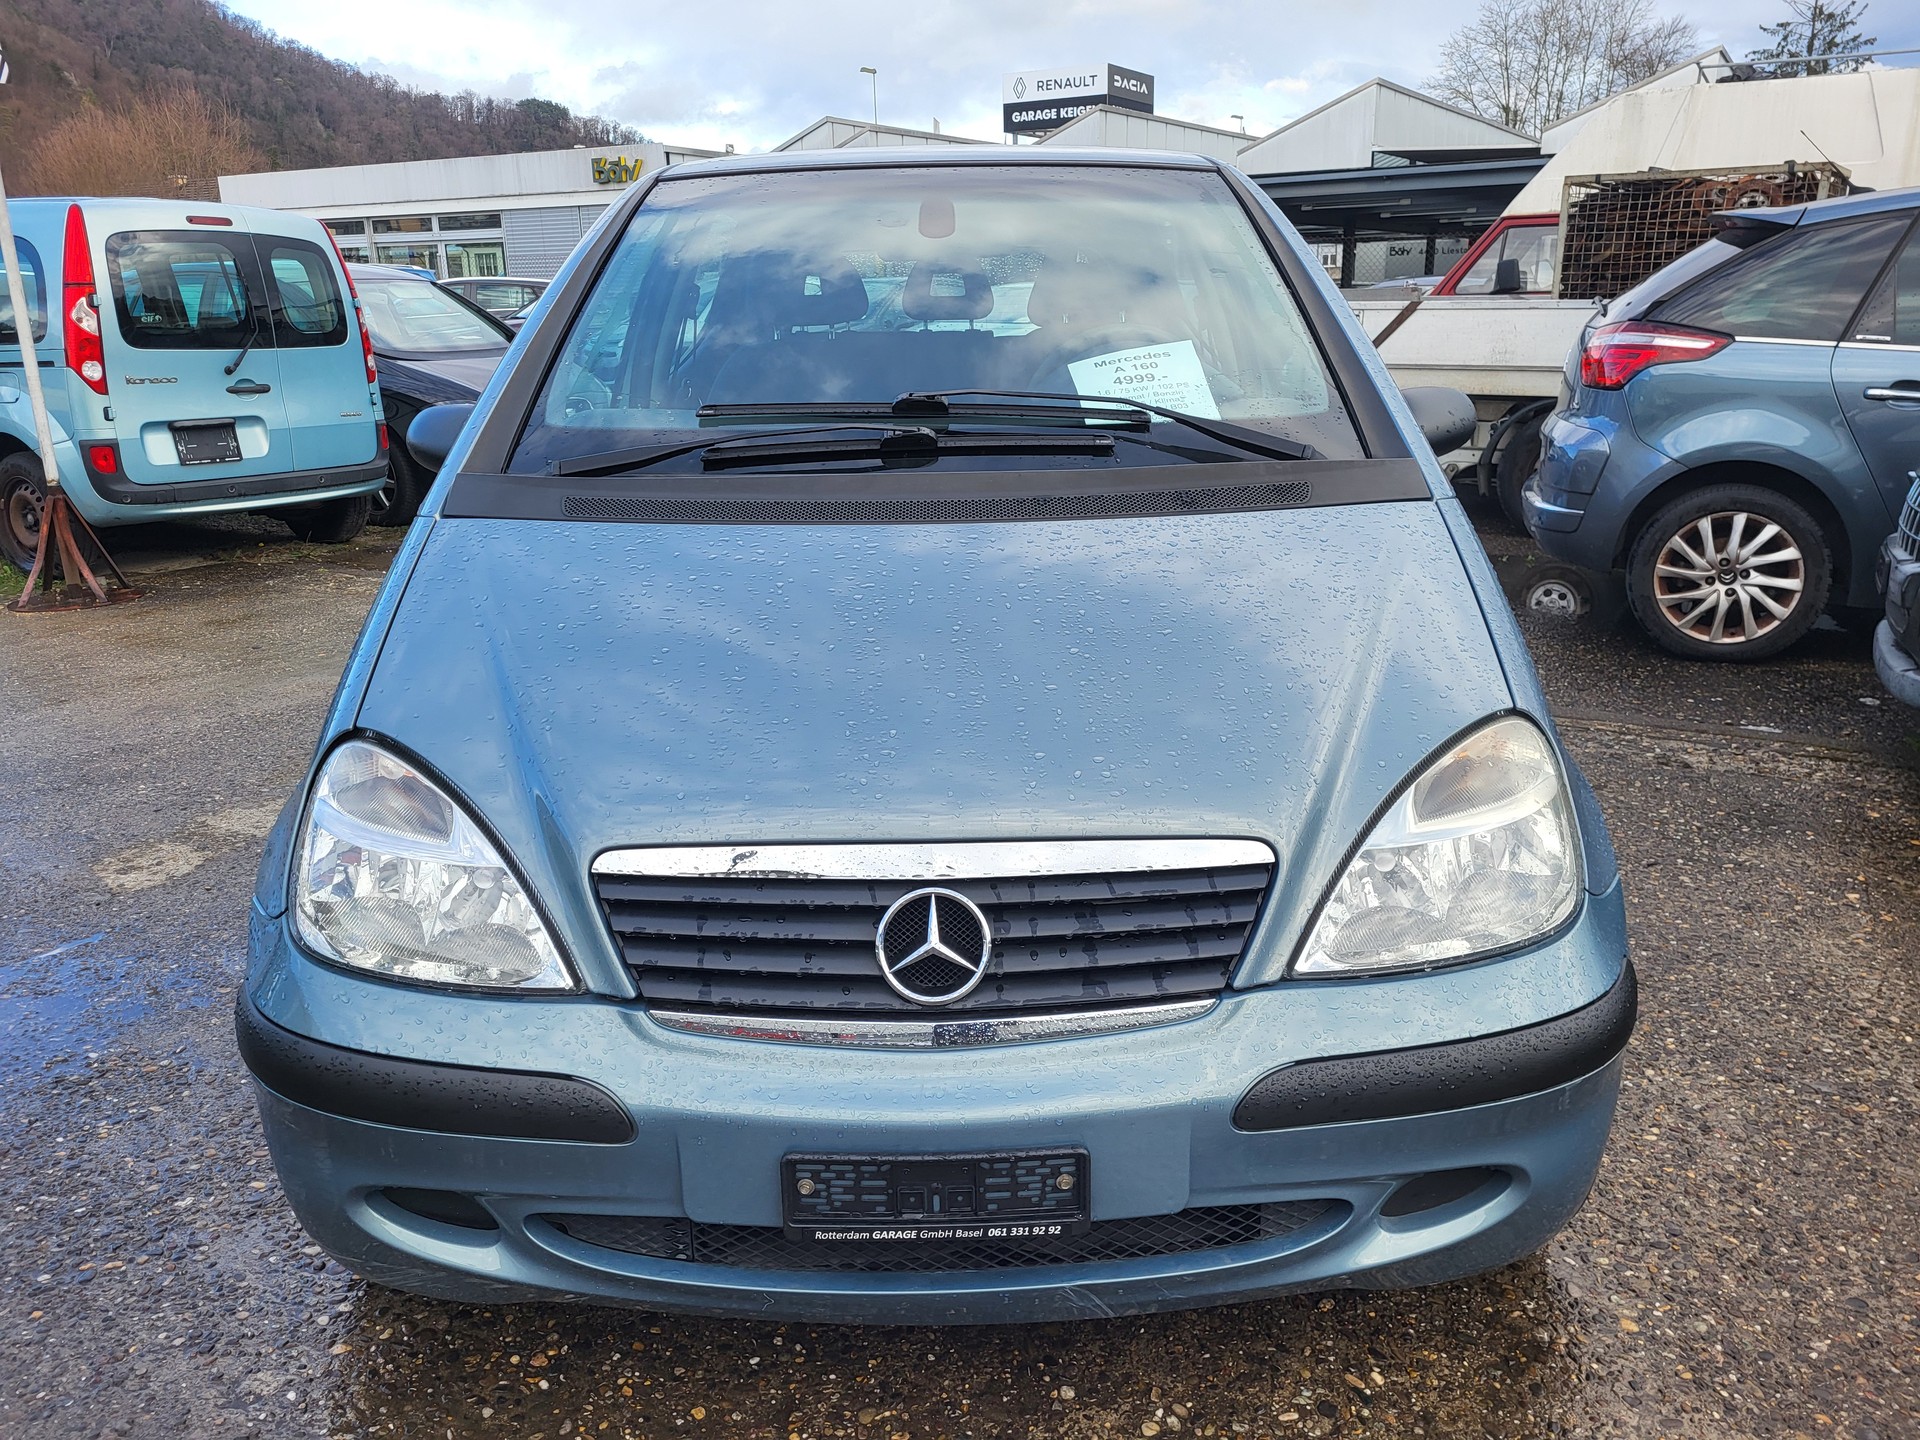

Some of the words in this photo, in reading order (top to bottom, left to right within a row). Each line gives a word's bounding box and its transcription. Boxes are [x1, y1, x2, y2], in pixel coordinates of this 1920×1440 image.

[1036, 74, 1098, 92] RENAULT
[1113, 75, 1149, 95] DACIA
[1011, 108, 1057, 123] GARAGE
[1093, 351, 1172, 368] Mercedes
[1114, 366, 1126, 374] A
[1131, 361, 1159, 371] 160
[1113, 372, 1168, 386] 4999.-
[1120, 387, 1131, 395] 75
[1133, 385, 1149, 393] KW
[815, 1230, 870, 1240] Rotterdam
[872, 1229, 918, 1239] GARAGE
[920, 1228, 953, 1238] GmbH
[955, 1228, 983, 1238] Basel
[988, 1227, 1008, 1237] 061
[1010, 1226, 1030, 1236] 331
[1032, 1225, 1046, 1235] 92
[1048, 1225, 1062, 1235] 92
